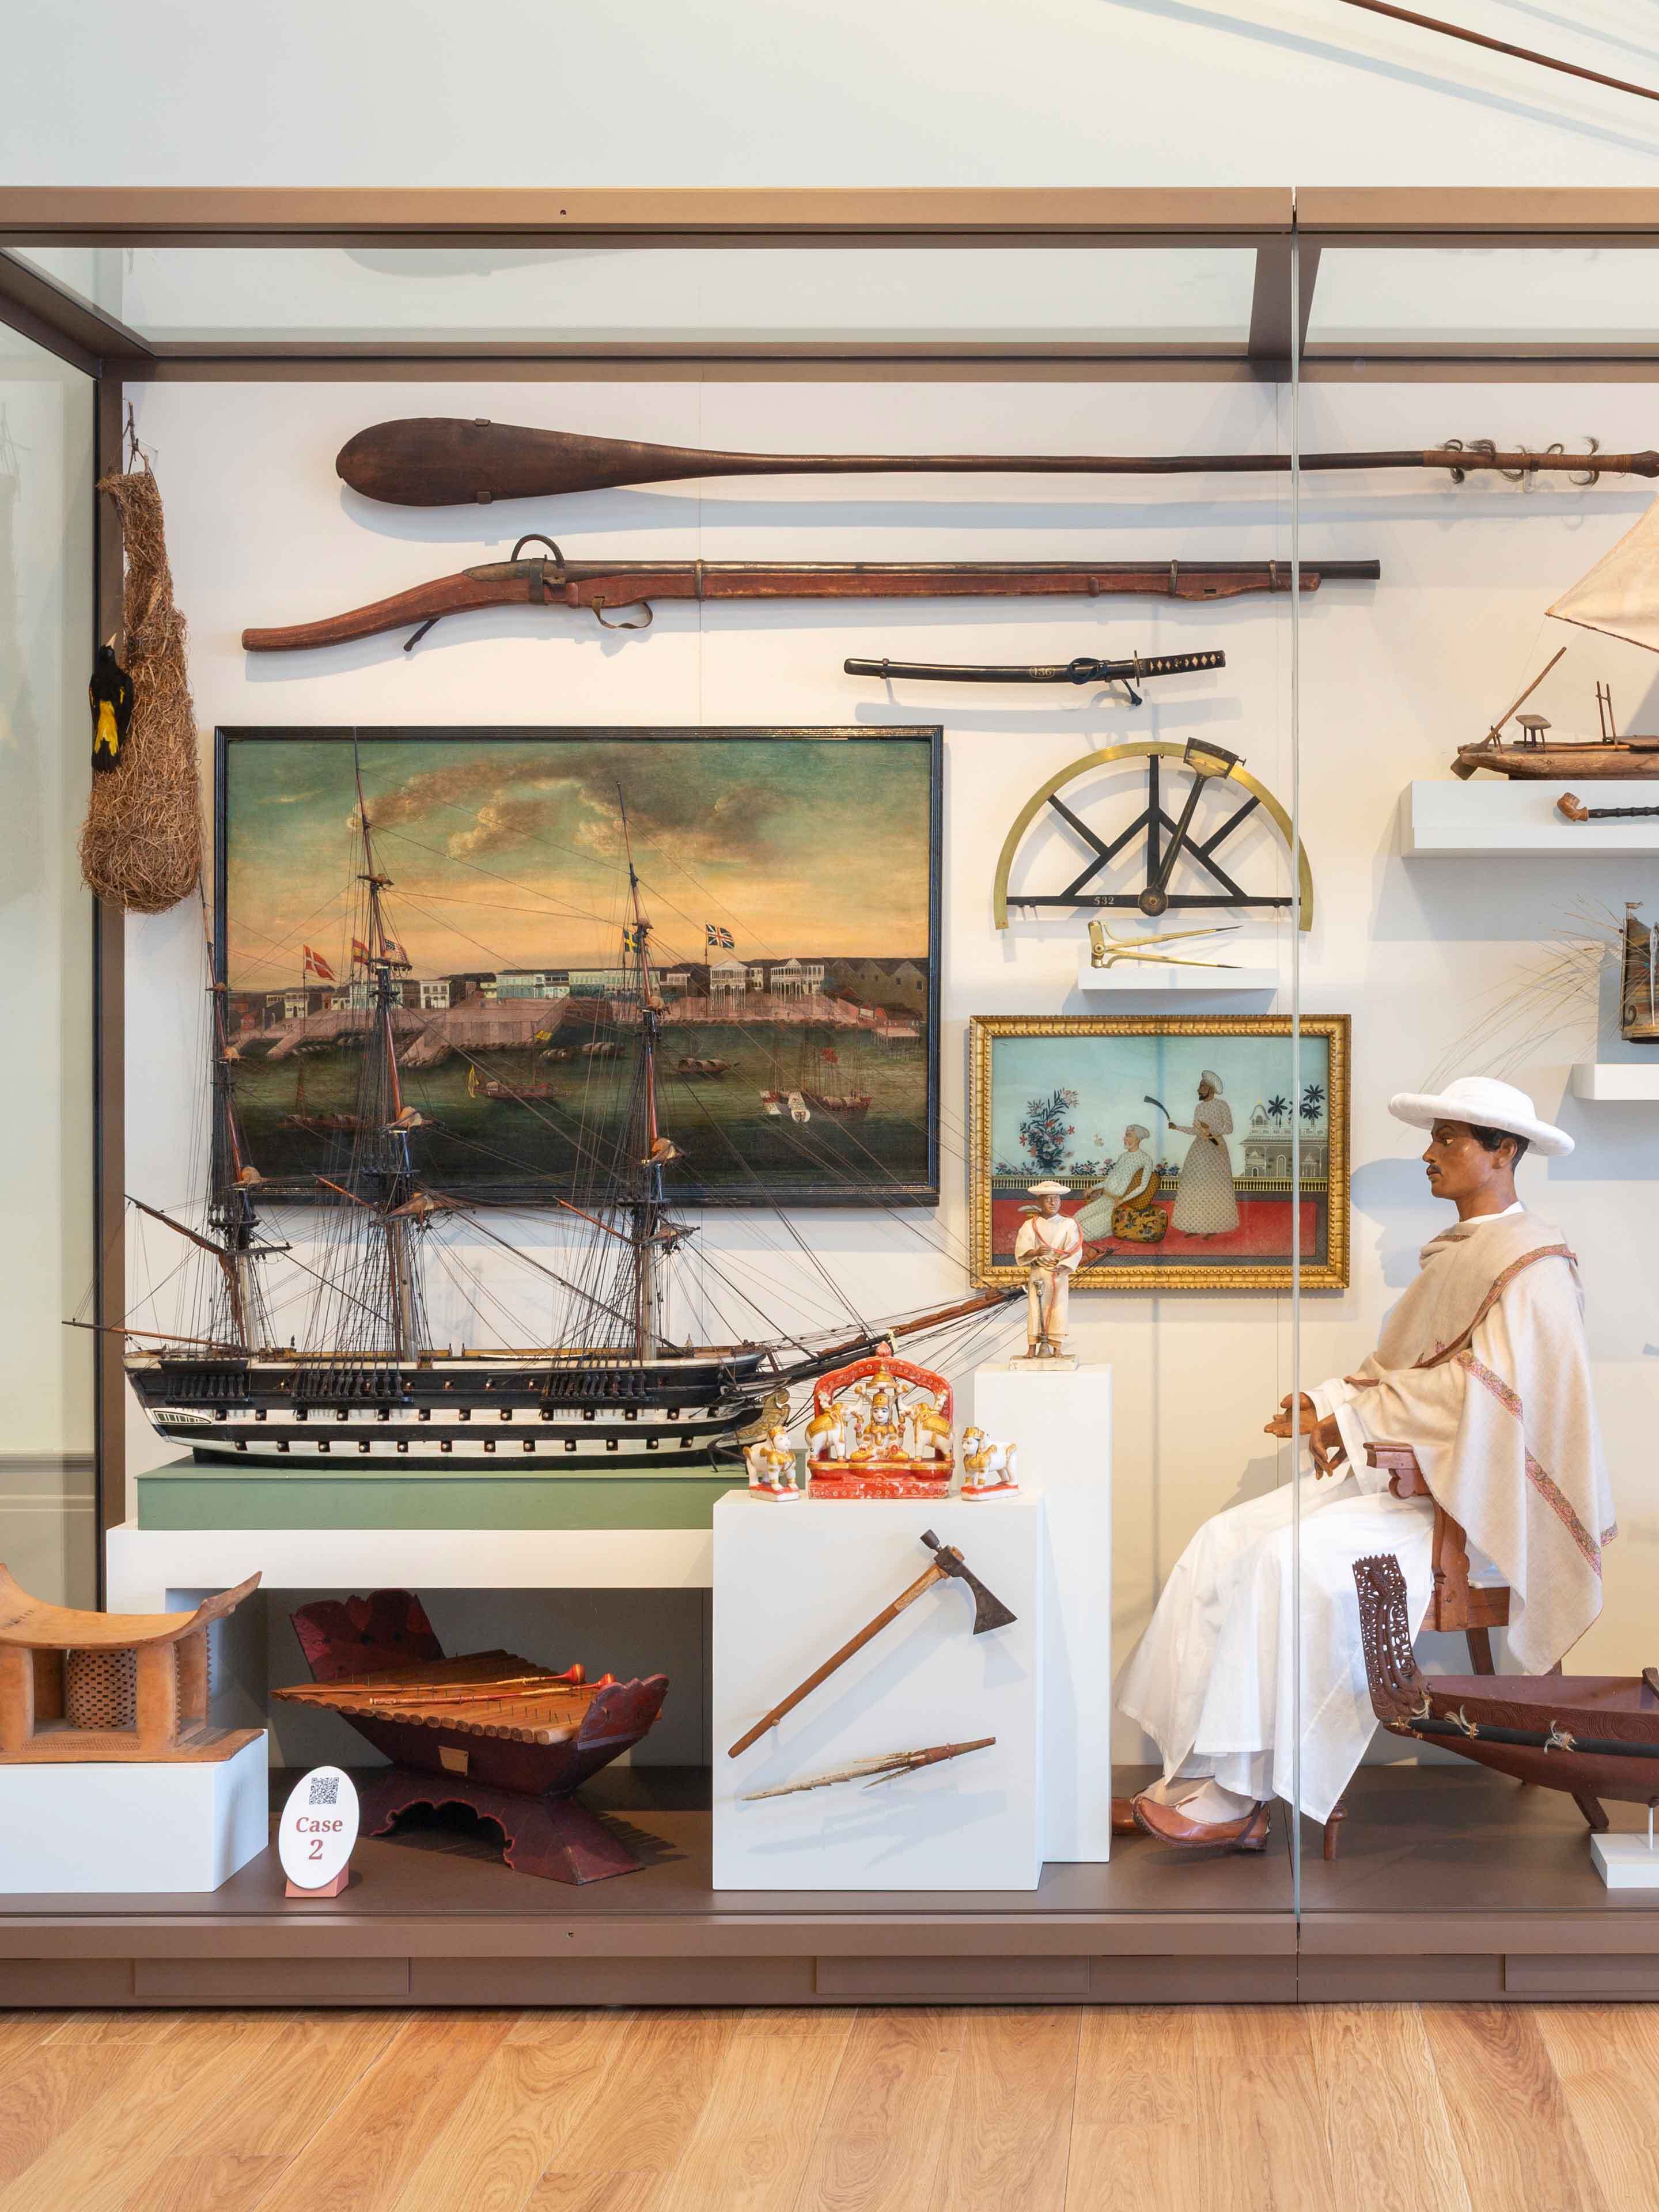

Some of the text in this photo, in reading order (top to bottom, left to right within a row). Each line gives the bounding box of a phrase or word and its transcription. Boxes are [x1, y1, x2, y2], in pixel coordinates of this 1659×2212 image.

[1093, 896, 1115, 905] 532
[296, 1816, 343, 1832] Case
[308, 1839, 323, 1860] 2
